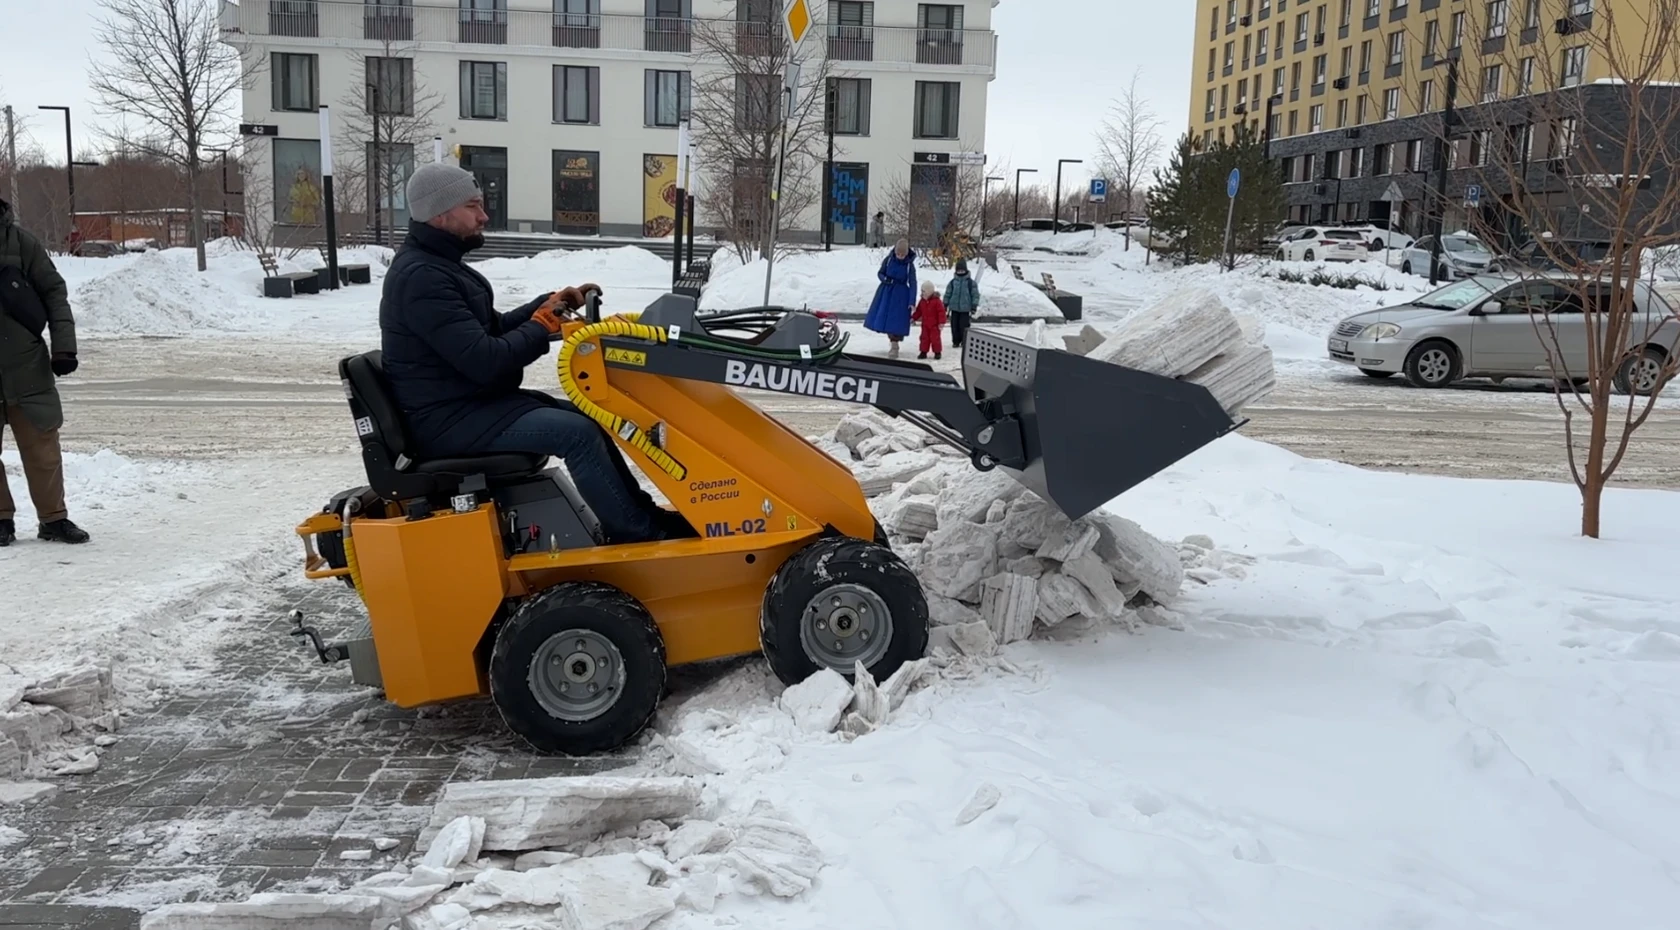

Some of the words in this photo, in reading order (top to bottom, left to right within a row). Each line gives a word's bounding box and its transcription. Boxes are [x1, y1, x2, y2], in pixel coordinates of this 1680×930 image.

[252, 126, 264, 134] 42
[926, 154, 938, 162] 42
[1094, 181, 1104, 194] P
[724, 358, 880, 405] BAUMECH
[689, 477, 737, 492] Сделано
[690, 495, 697, 504] в
[700, 490, 740, 503] России
[705, 518, 767, 538] ML-02
